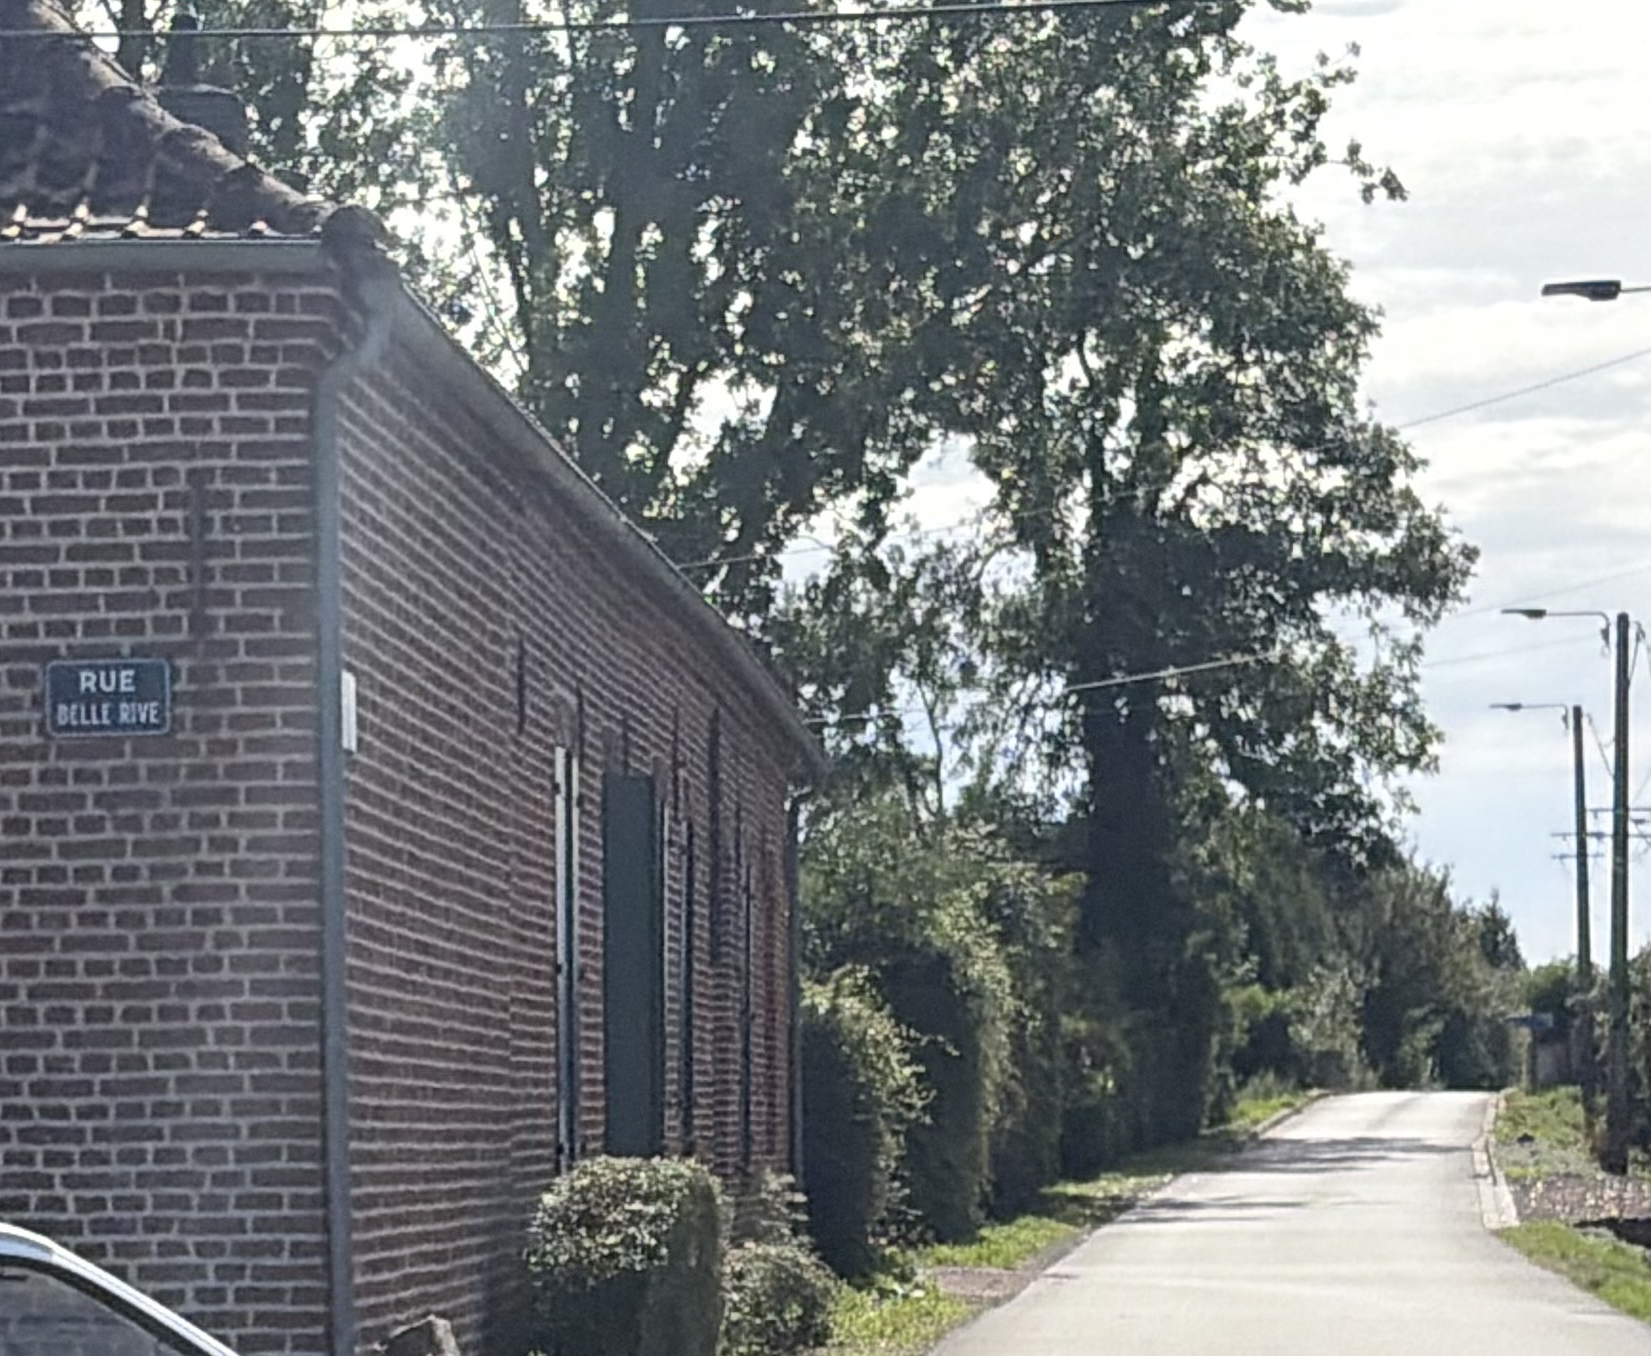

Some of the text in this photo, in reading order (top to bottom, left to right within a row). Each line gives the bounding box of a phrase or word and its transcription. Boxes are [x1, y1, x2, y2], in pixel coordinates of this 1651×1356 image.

[79, 670, 136, 694] RUE
[57, 701, 160, 726] BELLE RIVE
